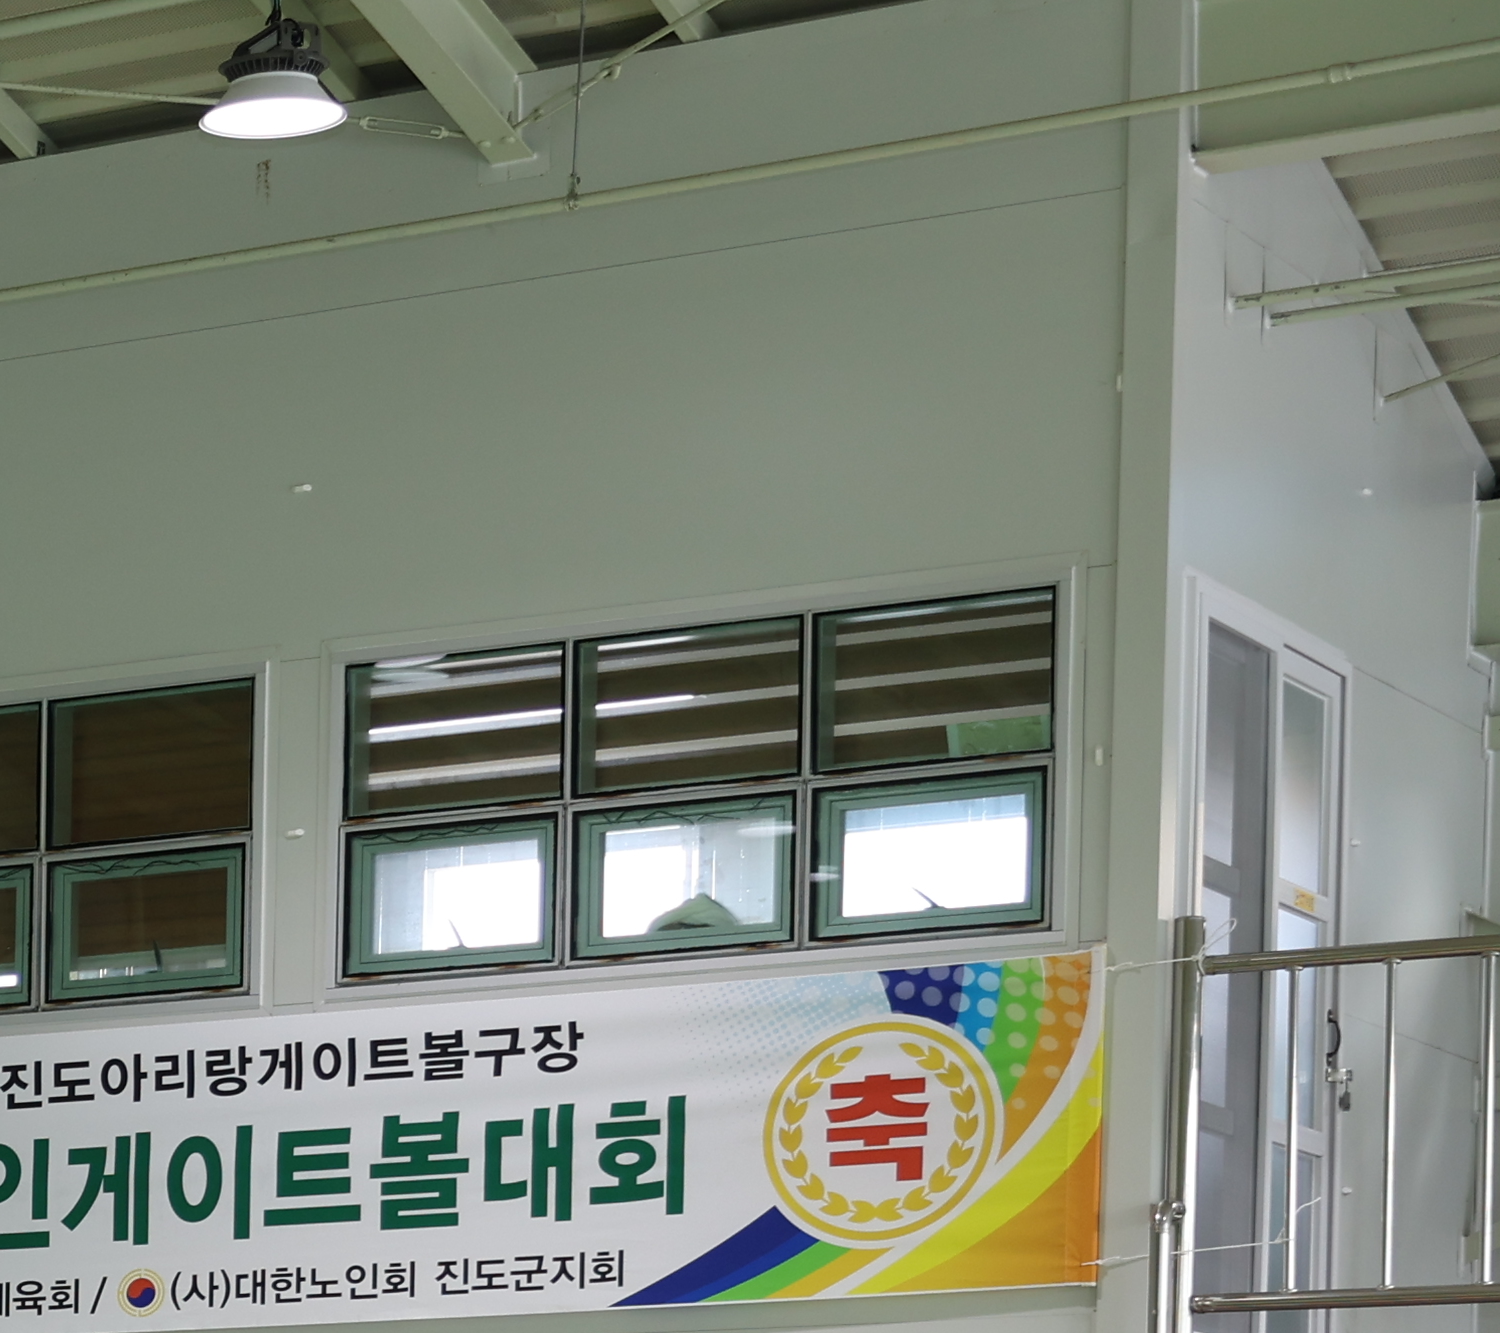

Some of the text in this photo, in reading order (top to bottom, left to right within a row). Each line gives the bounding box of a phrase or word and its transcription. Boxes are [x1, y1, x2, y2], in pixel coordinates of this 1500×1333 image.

[0, 1021, 583, 1109] 진도아리랑게이트볼구장
[819, 1067, 928, 1183] 축
[171, 1262, 415, 1310] (사)대한노인회
[436, 1250, 623, 1295] 진도군지회
